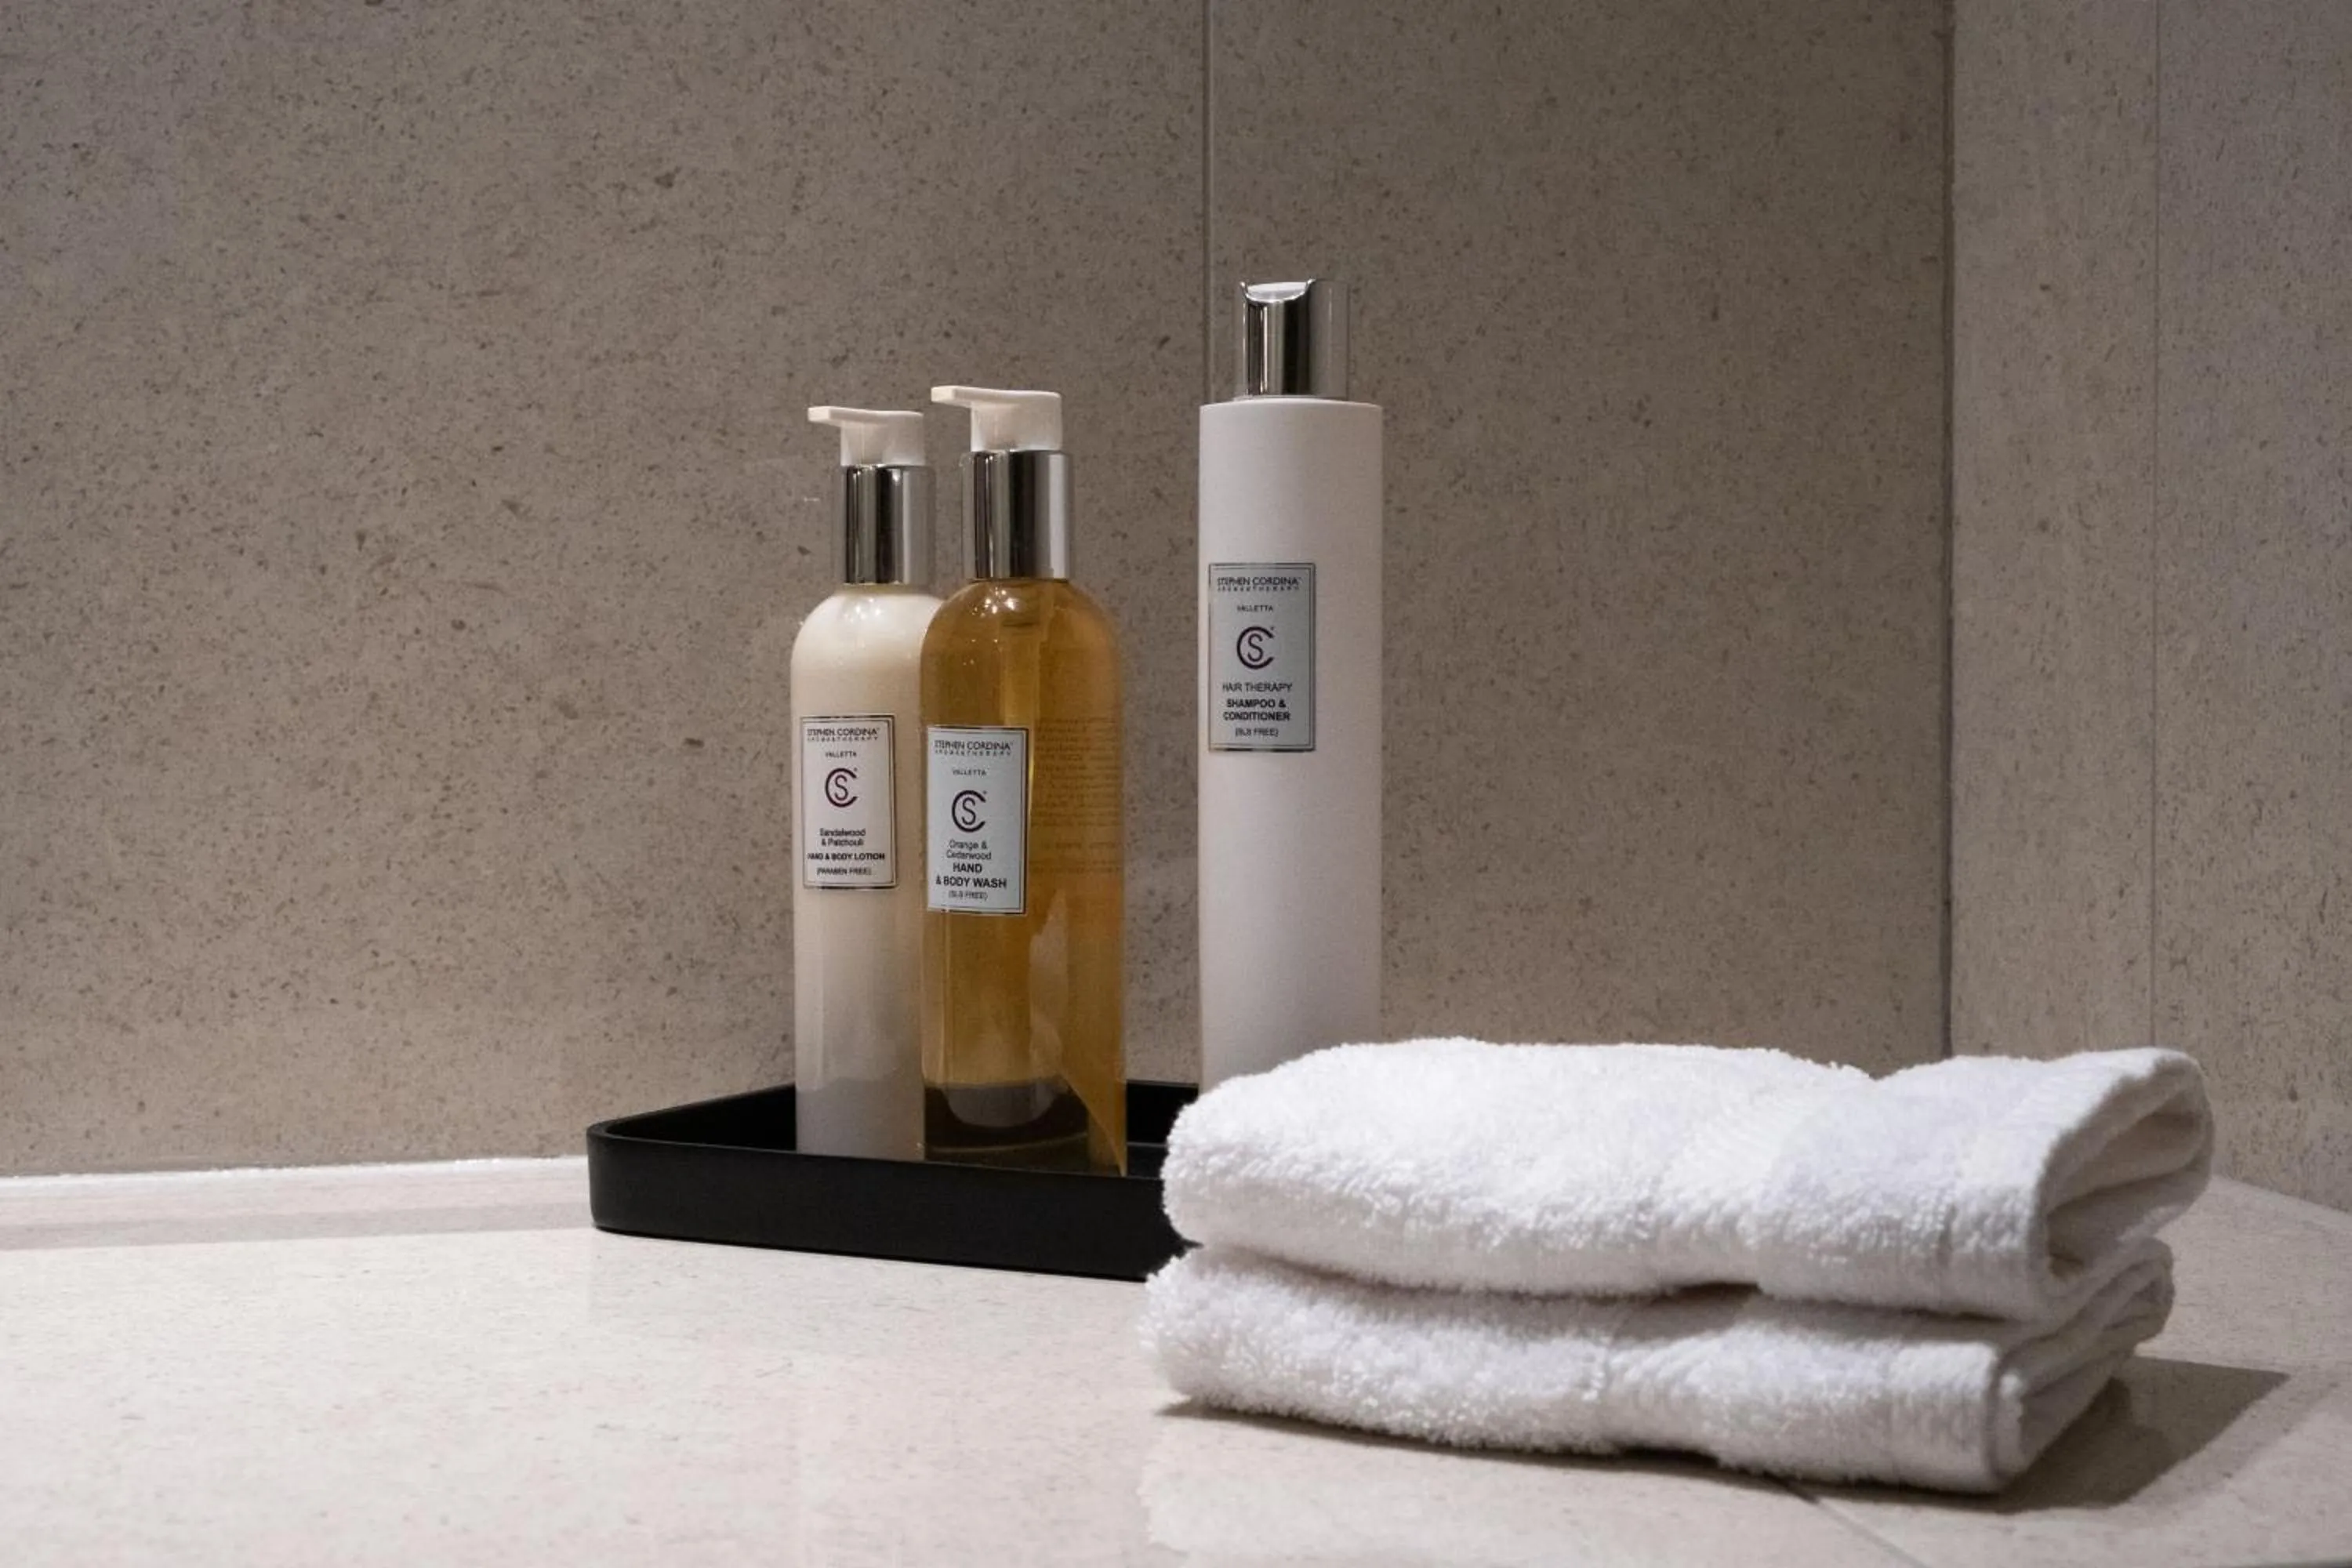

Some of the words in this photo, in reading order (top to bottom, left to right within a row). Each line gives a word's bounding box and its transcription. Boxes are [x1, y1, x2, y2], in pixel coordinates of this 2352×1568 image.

[1222, 682, 1243, 691] HAIR
[1245, 682, 1293, 692] THERAPY
[1227, 699, 1276, 708] SHAMPOO
[1279, 699, 1287, 708] &
[1223, 711, 1290, 720] CONDITIONER
[819, 828, 866, 837] Sandalwood
[949, 840, 979, 851] Orange
[982, 840, 988, 850] &
[831, 852, 852, 861] BODY
[854, 852, 885, 861] LOTION
[946, 849, 992, 860] Cedarwood
[953, 862, 982, 873] HAND
[936, 875, 942, 885] &
[943, 876, 971, 887] BODY
[973, 877, 1007, 889] WASH
